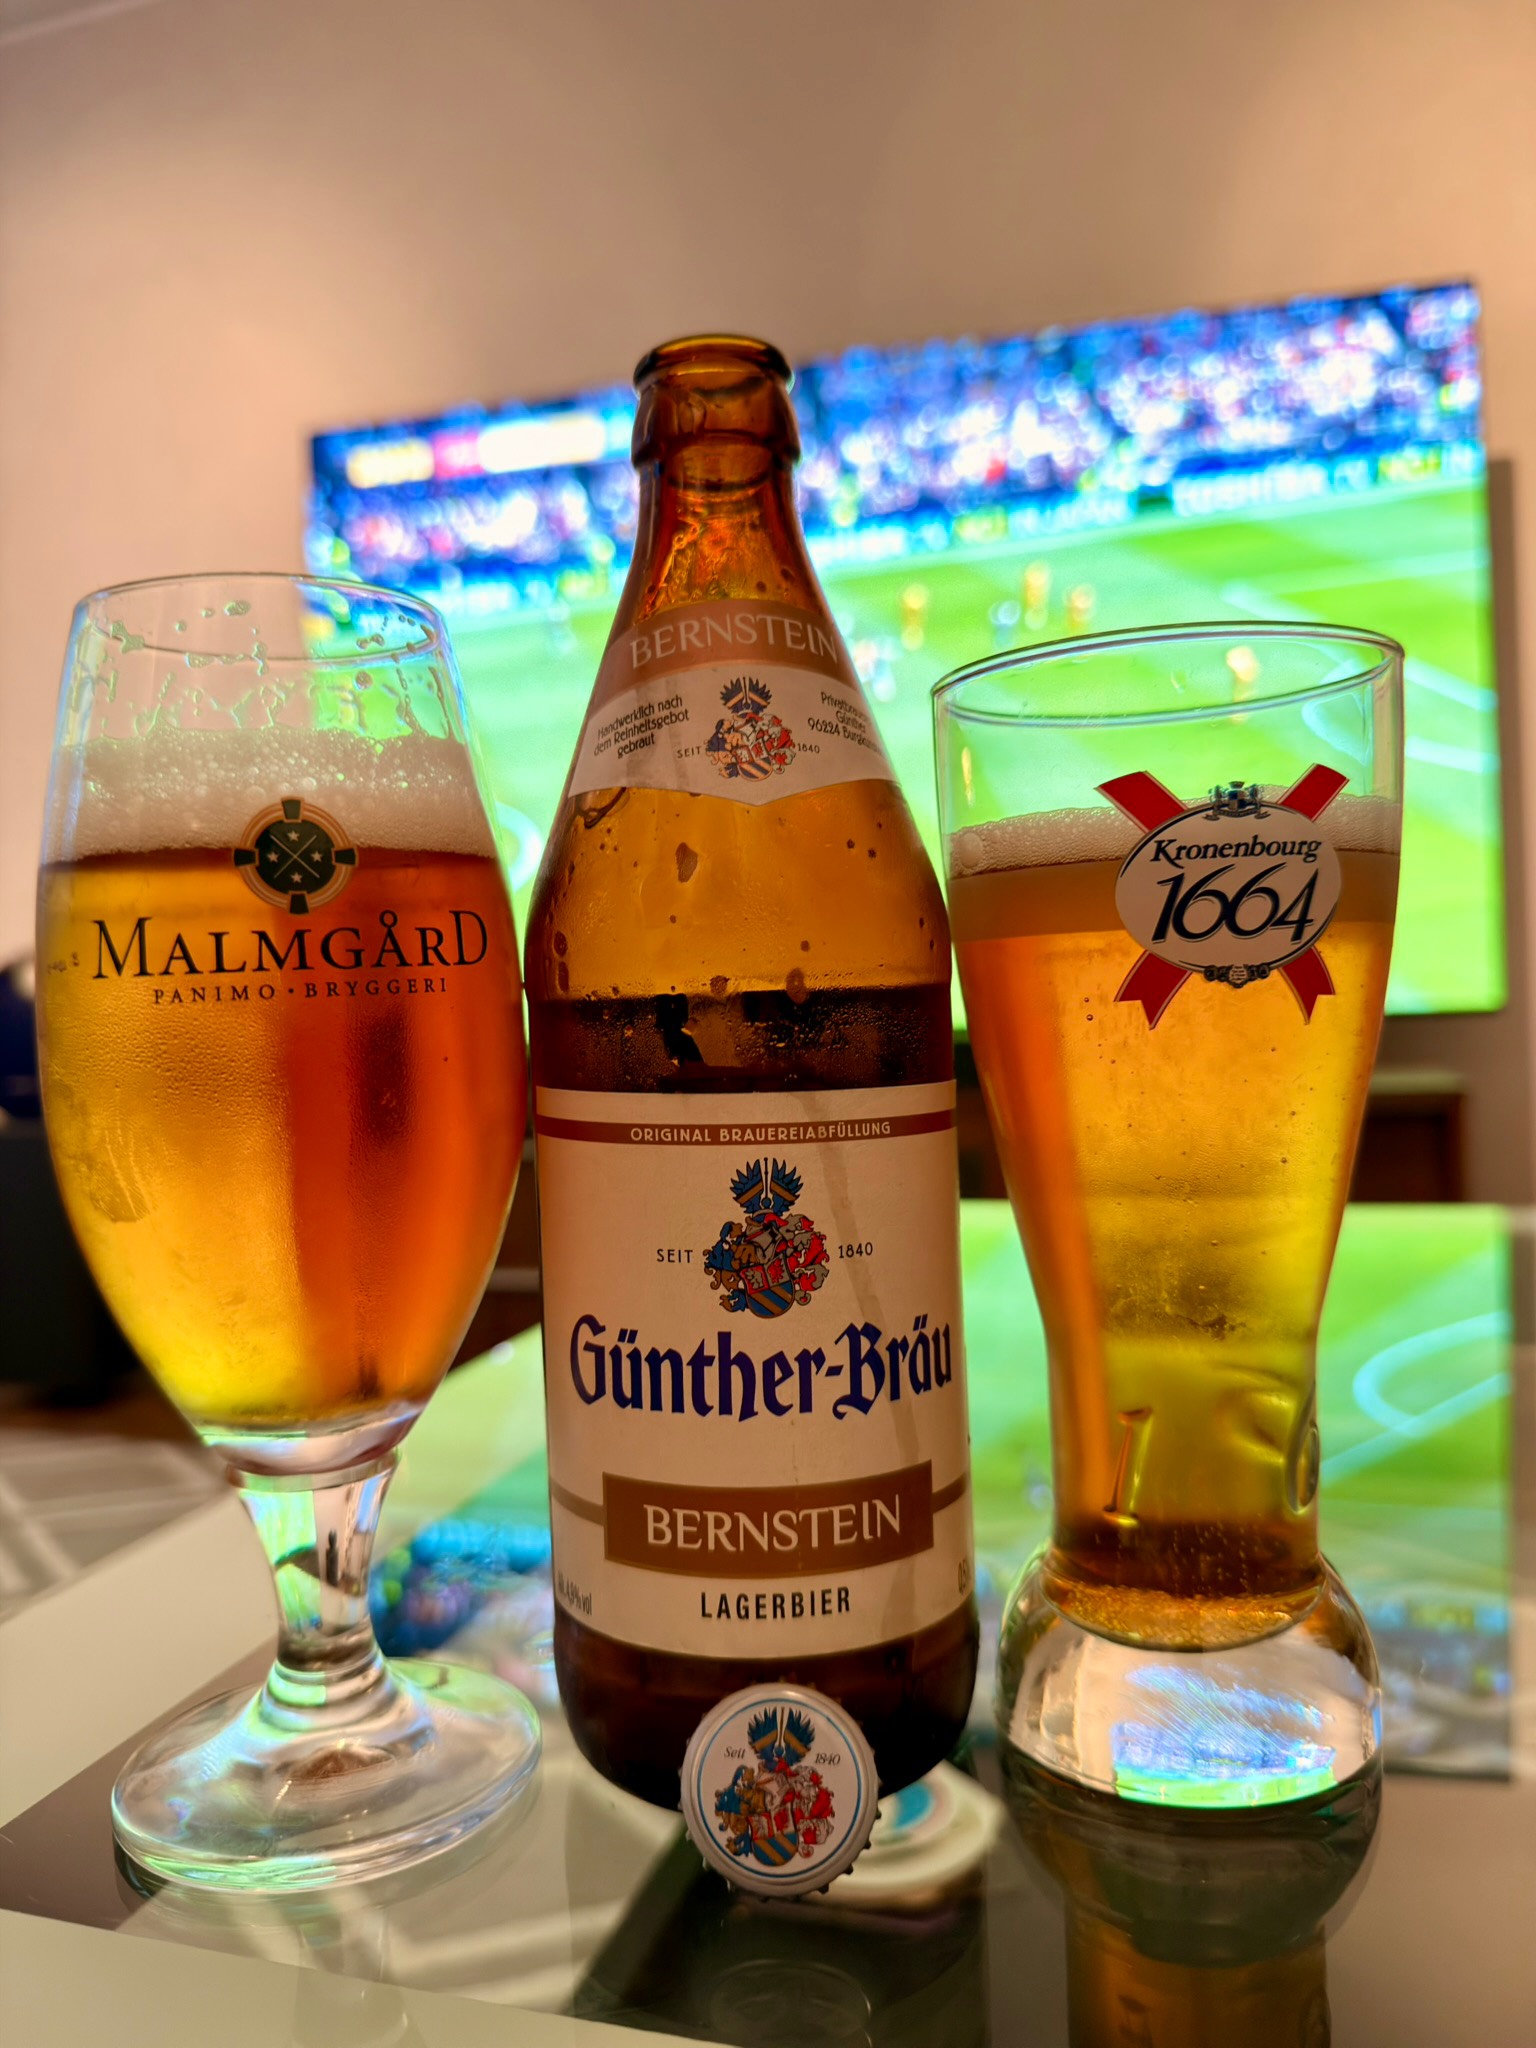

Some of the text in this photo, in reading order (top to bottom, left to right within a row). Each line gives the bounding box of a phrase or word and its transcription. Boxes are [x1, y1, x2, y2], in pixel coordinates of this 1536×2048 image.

[629, 613, 838, 669] BERNSTEIN
[593, 708, 689, 757] dem Reinheitsgebot
[597, 694, 683, 739] Handwerklich nach
[807, 717, 840, 736] 96224
[617, 732, 656, 759] gebraut
[676, 744, 820, 758] SEIT 1840
[1150, 834, 1322, 869] Kronenbourg
[1151, 862, 1319, 945] 1664
[92, 909, 488, 979] MALMGÅRD
[154, 977, 447, 1005] PANIMO BRYGGERI
[630, 1121, 891, 1143] ORIGINAL BRAUEREIABFÜLLUNG
[656, 1241, 873, 1264] SEIT 1840
[570, 1313, 952, 1422] Günther-Bräu
[642, 1494, 901, 1553] BERNSTEIN
[581, 1592, 593, 1616] vol
[700, 1586, 851, 1620] LAGERBIER
[723, 1746, 841, 1766] Seit 1840
